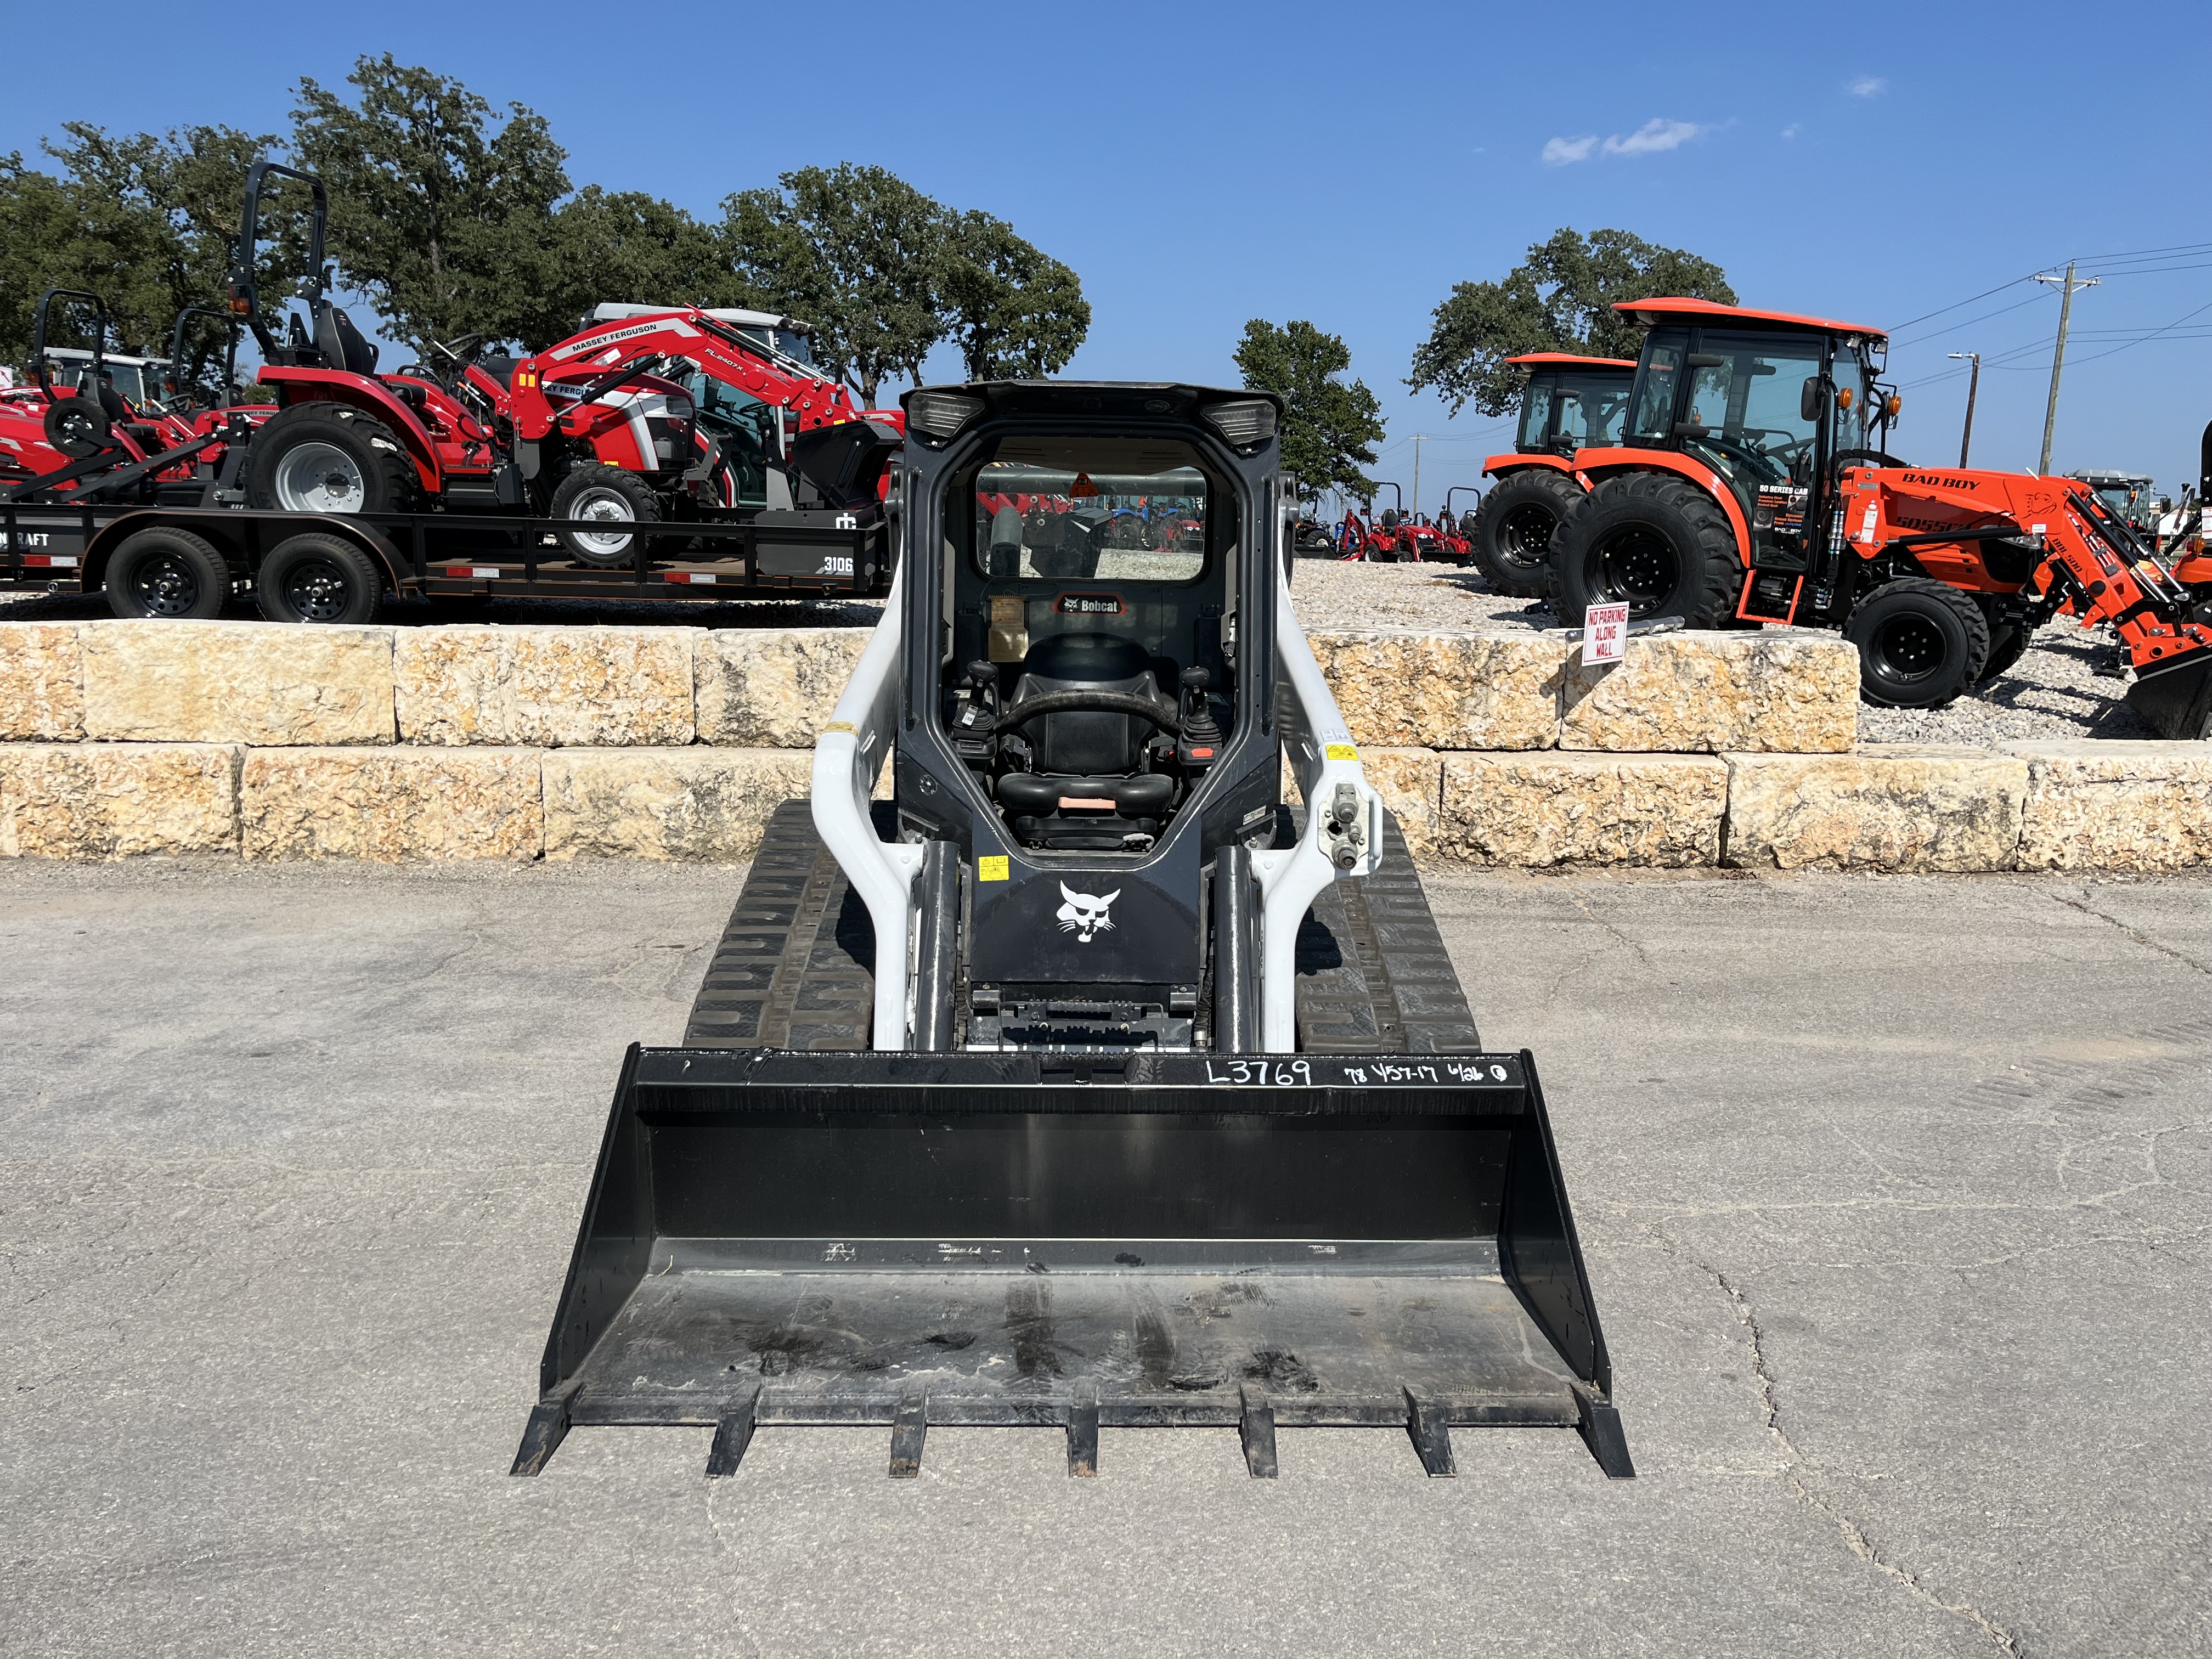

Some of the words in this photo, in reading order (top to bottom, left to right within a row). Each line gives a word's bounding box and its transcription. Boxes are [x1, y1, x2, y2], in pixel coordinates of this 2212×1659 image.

[572, 336, 607, 352] MASSEY
[610, 324, 657, 340] FERGUSON
[1902, 473, 1940, 486] BAD
[1942, 478, 1981, 490] BOY
[1769, 486, 1793, 494] SERIES
[824, 556, 853, 572] 3106
[1081, 600, 1118, 612] Bobcat
[1589, 611, 1598, 625] NO
[1599, 608, 1626, 625] PARKING
[1595, 625, 1616, 641] ALONG
[1596, 642, 1612, 658] WALL
[1206, 1060, 1311, 1085] L3769
